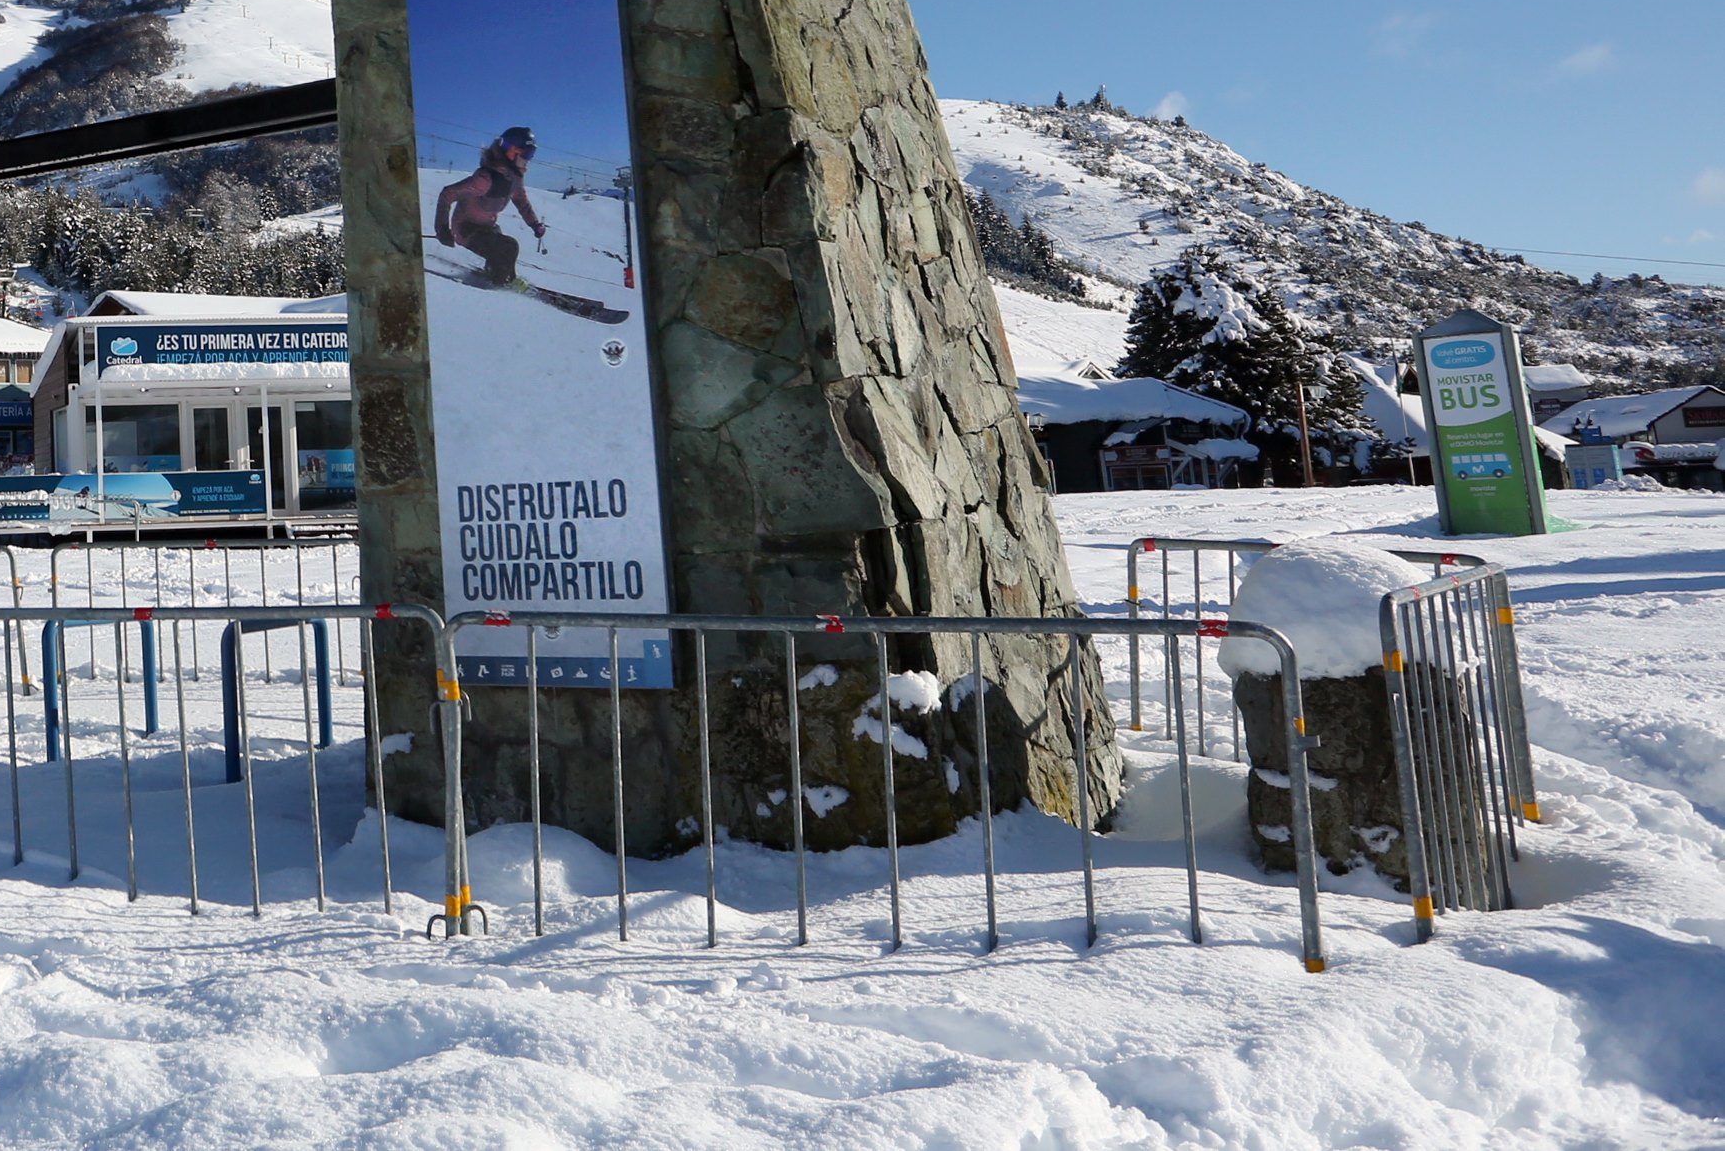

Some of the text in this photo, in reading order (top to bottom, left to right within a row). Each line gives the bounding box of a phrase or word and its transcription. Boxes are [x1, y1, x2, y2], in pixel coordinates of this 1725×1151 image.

[156, 332, 348, 350] ¿ES TU PRIMERA VEZ EN CATEDR
[1455, 346, 1487, 355] GRATIS
[106, 355, 143, 365] Catedral
[1437, 373, 1494, 386] MOVISTAR
[1439, 385, 1500, 410] BUS
[458, 478, 627, 523] DISFRUTALO
[460, 521, 578, 562] CUIDALO
[462, 560, 644, 601] COMPARTILO
